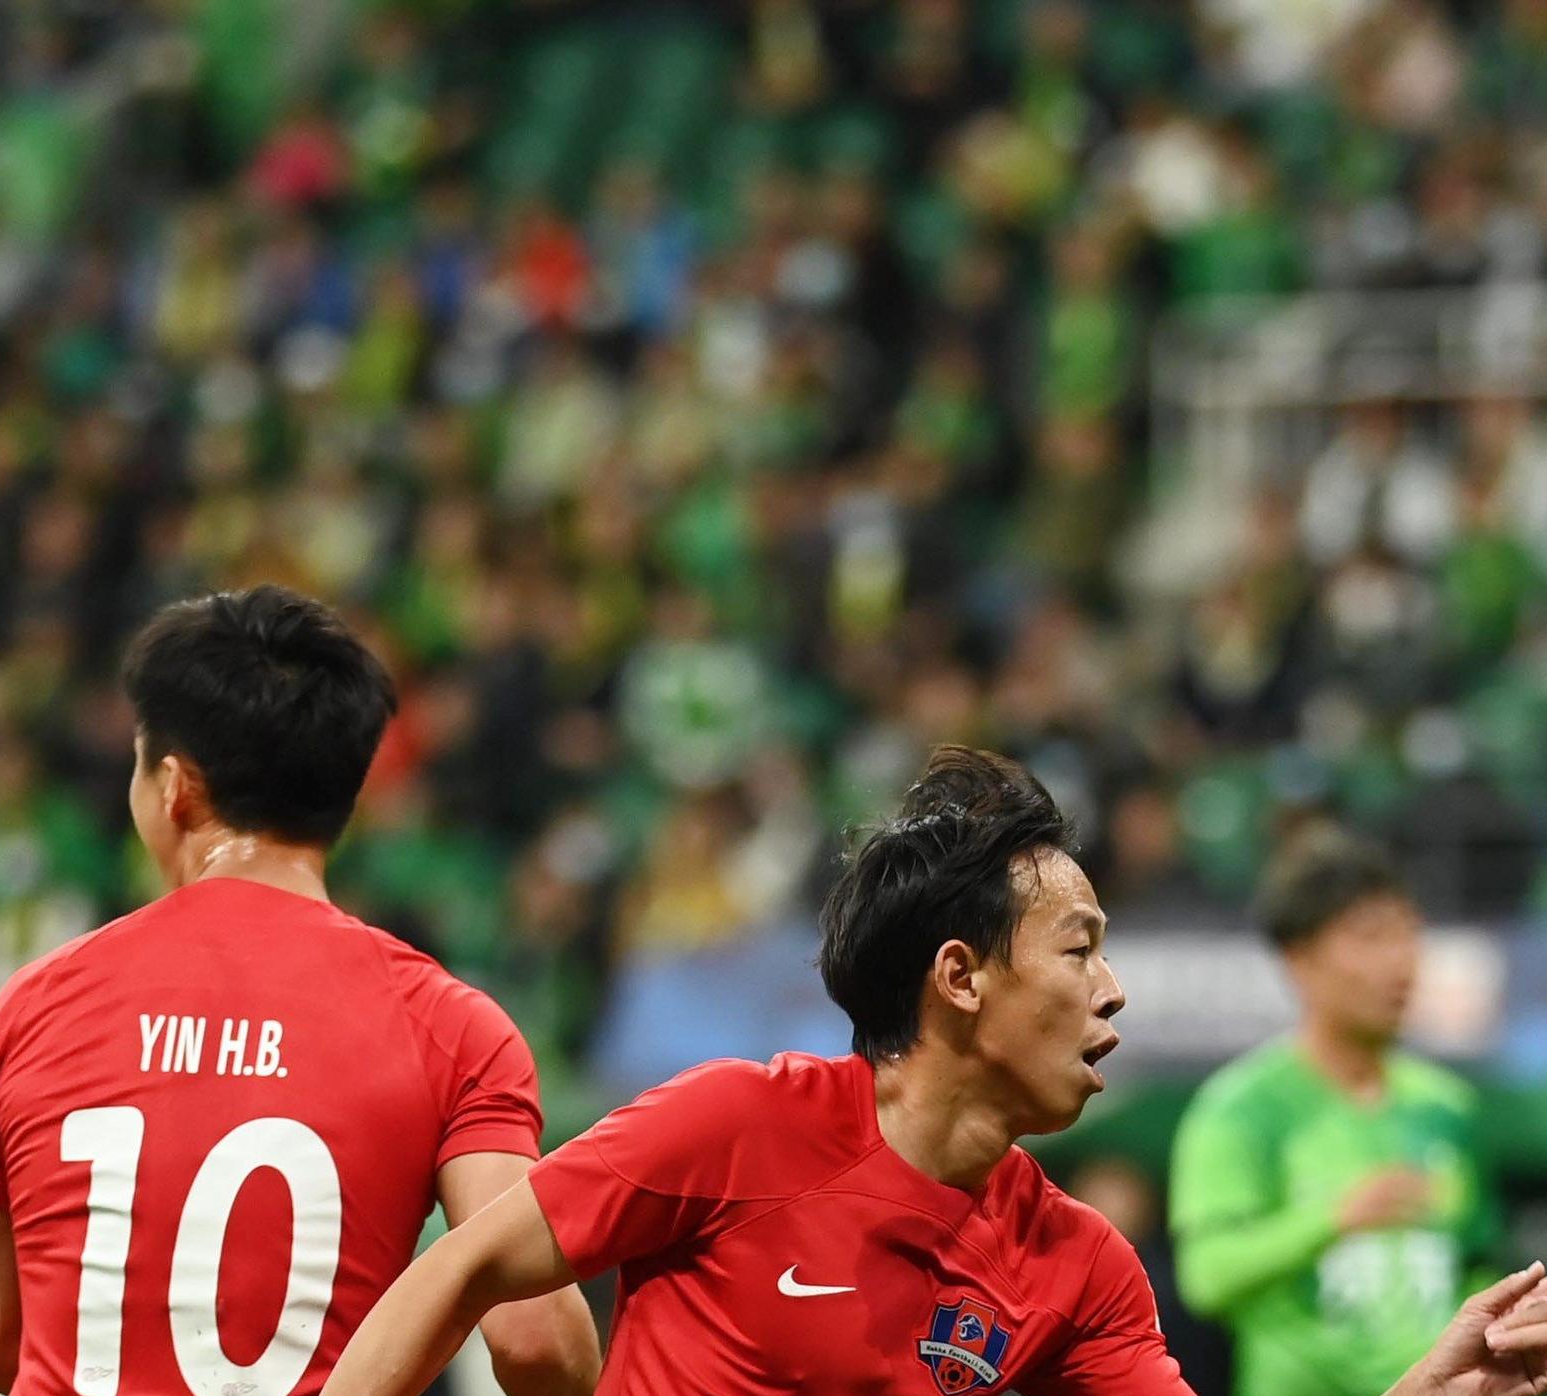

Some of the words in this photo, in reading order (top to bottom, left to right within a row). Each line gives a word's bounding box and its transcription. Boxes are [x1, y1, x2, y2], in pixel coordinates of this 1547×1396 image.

[139, 1013, 206, 1075] YIN
[215, 1019, 289, 1078] H.B.
[949, 1349, 979, 1367] Football
